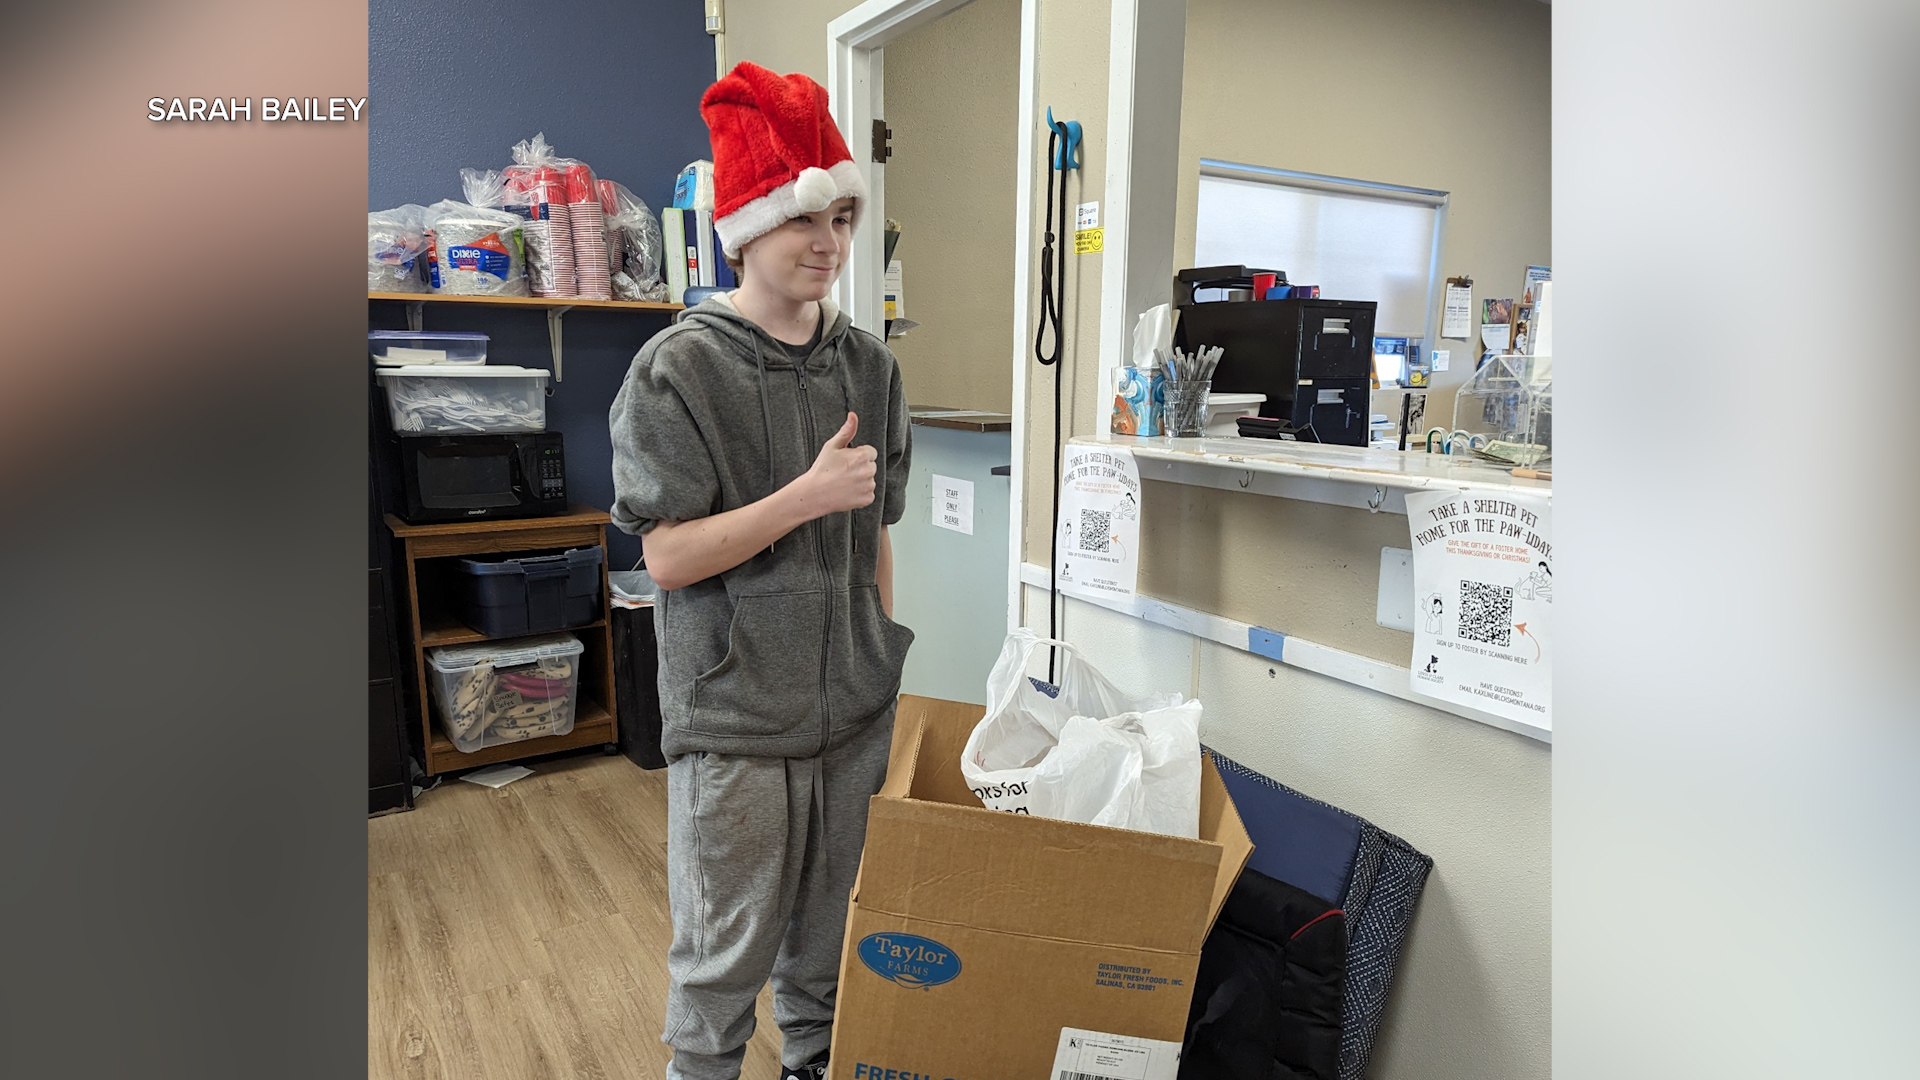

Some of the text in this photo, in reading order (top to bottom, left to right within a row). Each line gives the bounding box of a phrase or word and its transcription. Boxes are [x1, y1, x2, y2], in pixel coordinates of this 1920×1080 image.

[1084, 453, 1088, 463] A
[1114, 457, 1125, 471] PET
[946, 488, 959, 498] STAFF
[946, 502, 958, 511] ONLY
[944, 514, 959, 525] PLEASE
[1428, 499, 1539, 528] TAKE A SHELTER PET
[1415, 524, 1447, 546] HOME
[1449, 519, 1470, 535] FOR
[1475, 519, 1495, 533] THE
[1457, 548, 1492, 559] THANKSGIVING
[1470, 541, 1482, 549] GIFT
[1495, 544, 1514, 553] FOSTER
[1515, 547, 1528, 555] HOME
[1436, 639, 1447, 647] SIGN
[1461, 644, 1479, 654] FOSTER
[1480, 648, 1487, 656] BY
[1488, 650, 1513, 661] SCANNING
[1513, 656, 1528, 665] HERE
[1459, 684, 1473, 693] EMAIL
[1480, 682, 1523, 698] HAVE QUESTIONS?
[874, 936, 948, 965] Taylor
[887, 960, 929, 976] FARMS
[1098, 963, 1141, 974] DISTRIBUTED
[1097, 971, 1122, 980] TAYLOR
[1122, 974, 1145, 982] FRESH
[1096, 978, 1125, 989] SALINAS,
